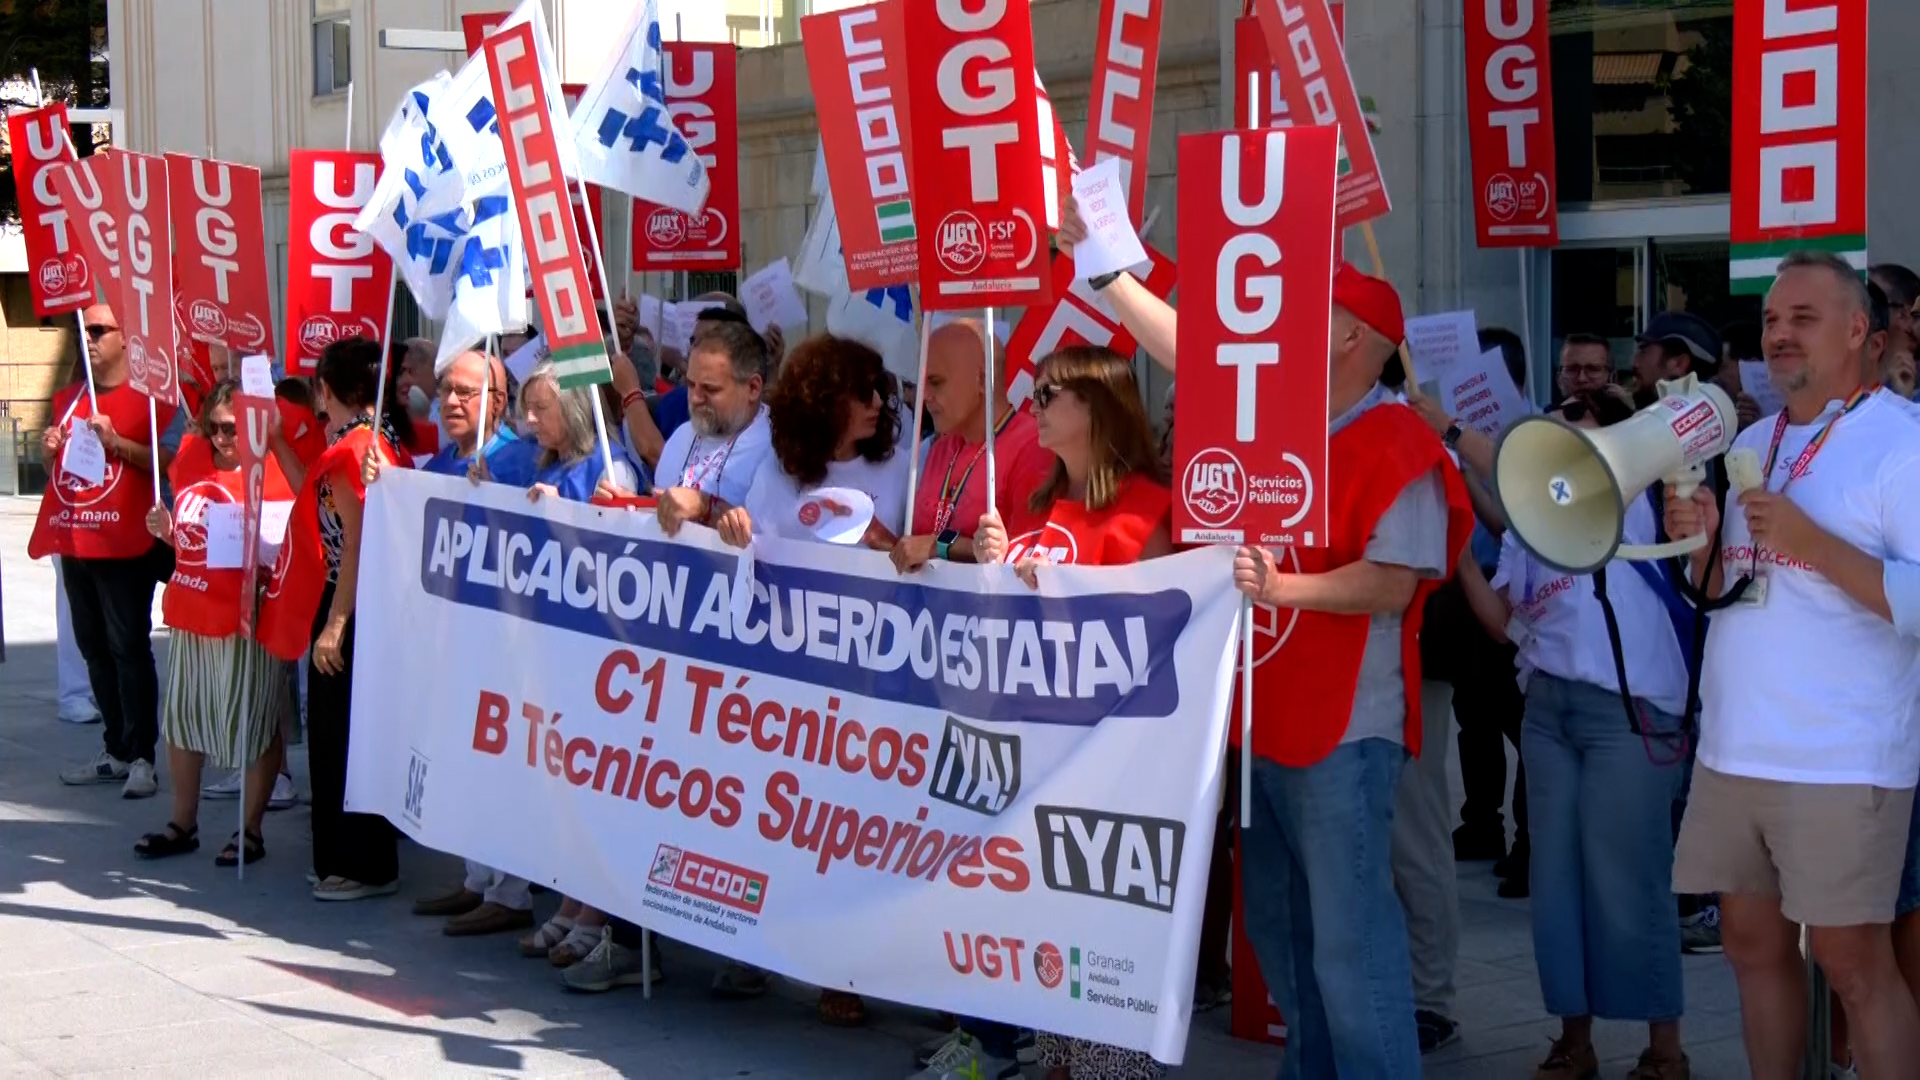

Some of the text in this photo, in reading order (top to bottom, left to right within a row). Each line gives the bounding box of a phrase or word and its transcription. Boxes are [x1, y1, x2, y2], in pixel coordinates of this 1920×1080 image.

[838, 9, 910, 199] CCOO
[495, 35, 588, 338] CCOO
[64, 160, 120, 278] UG
[190, 158, 240, 304] UGT
[988, 221, 1016, 240] FSP
[122, 153, 154, 337] UGT
[309, 160, 376, 312] UGT
[942, 222, 978, 248] UGT
[1215, 131, 1287, 442] UGT
[303, 323, 333, 340] UGT
[341, 325, 363, 336] FSP
[1190, 463, 1236, 493] UGT
[1249, 475, 1303, 488] Servicios
[1248, 488, 1299, 504] Públicos
[81, 511, 120, 522] mano
[1260, 533, 1294, 542] Granada
[429, 517, 690, 629] APLICACIÓN
[690, 572, 938, 680] ACUERDO
[594, 648, 1014, 811] C1 Técnicos ¡YA!
[471, 690, 1174, 906] B Técnicos Superiores ¡YA!
[680, 860, 747, 900] CCOO
[682, 896, 692, 905] de
[726, 909, 758, 926] sectores
[693, 914, 703, 924] de
[943, 930, 1026, 983] UGT
[1087, 950, 1135, 974] Granada
[1086, 989, 1125, 1009] Servicios
